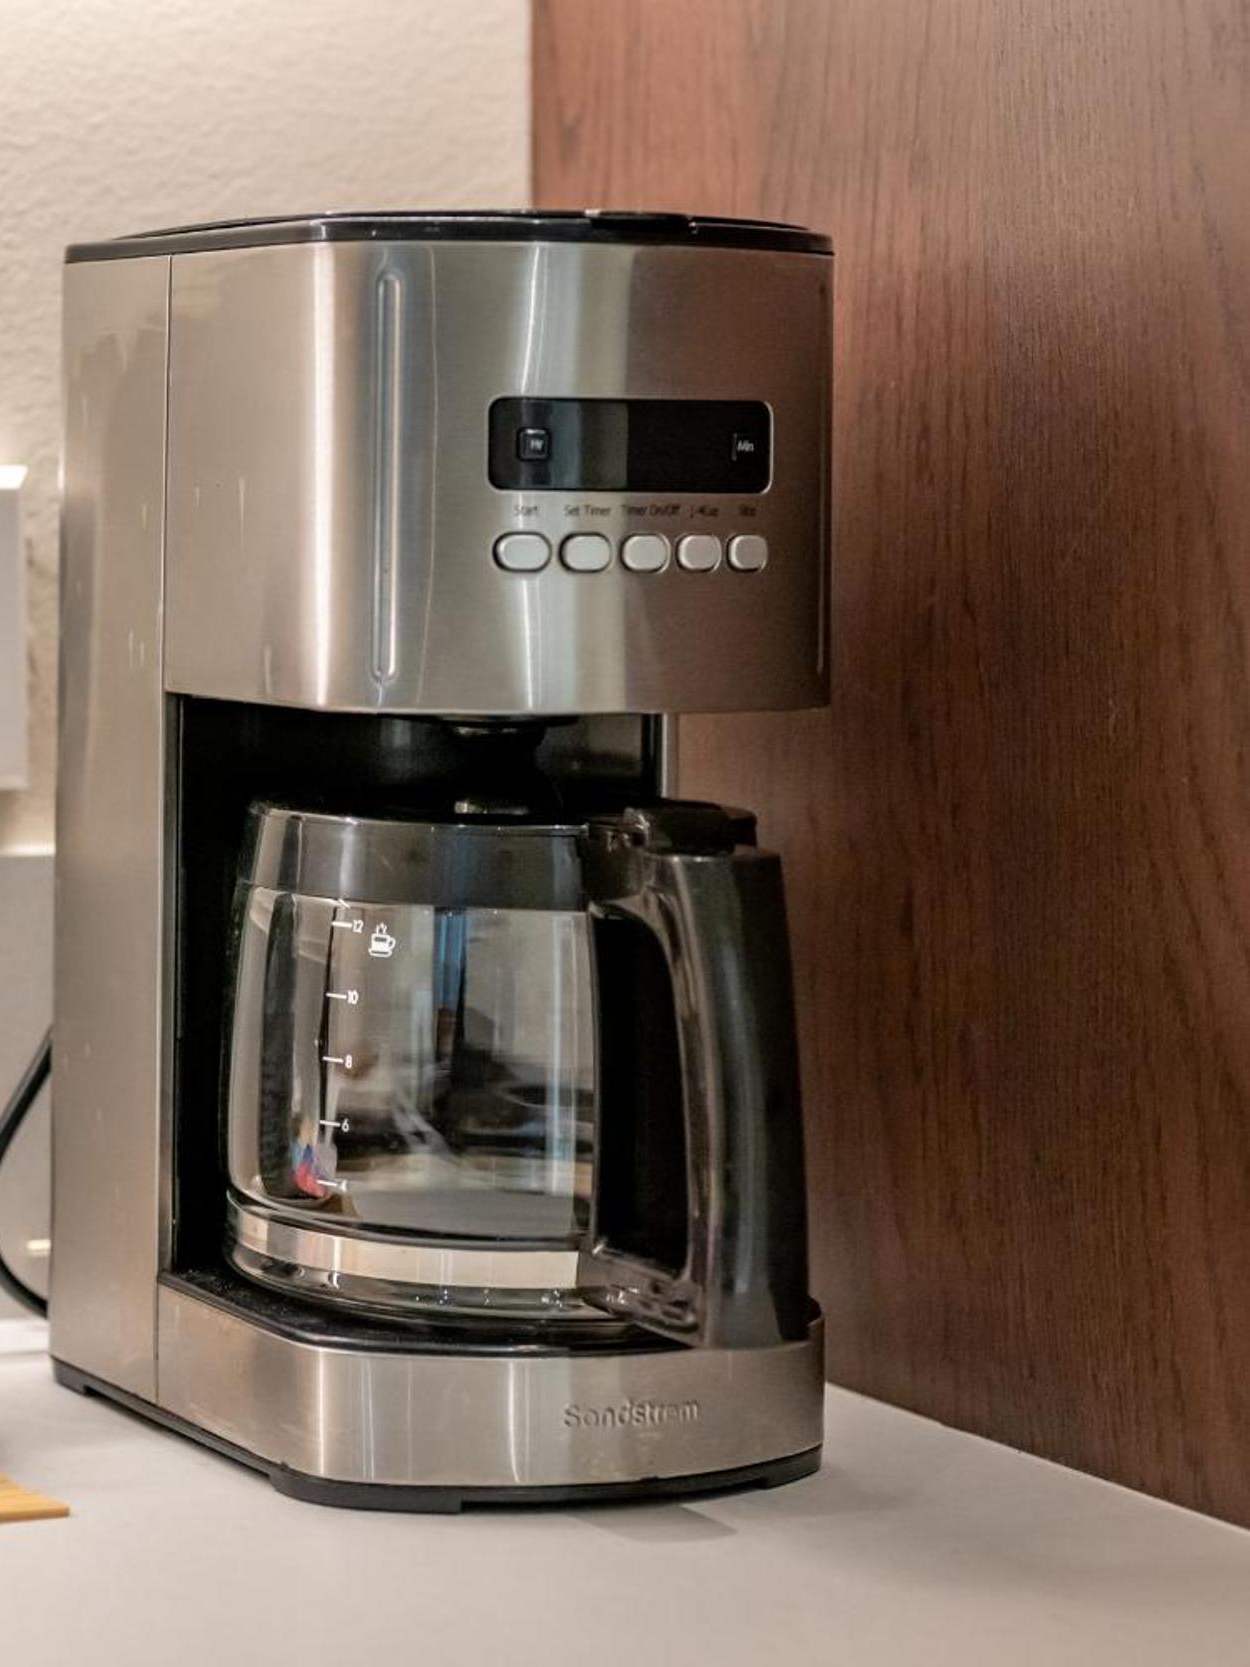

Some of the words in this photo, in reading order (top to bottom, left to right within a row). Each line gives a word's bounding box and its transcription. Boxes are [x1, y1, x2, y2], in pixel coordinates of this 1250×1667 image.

[563, 503, 580, 517] Set
[583, 503, 611, 517] Timer
[352, 919, 364, 934] 12
[347, 990, 359, 1005] 10
[344, 1054, 353, 1069] 8
[341, 1119, 350, 1132] 6
